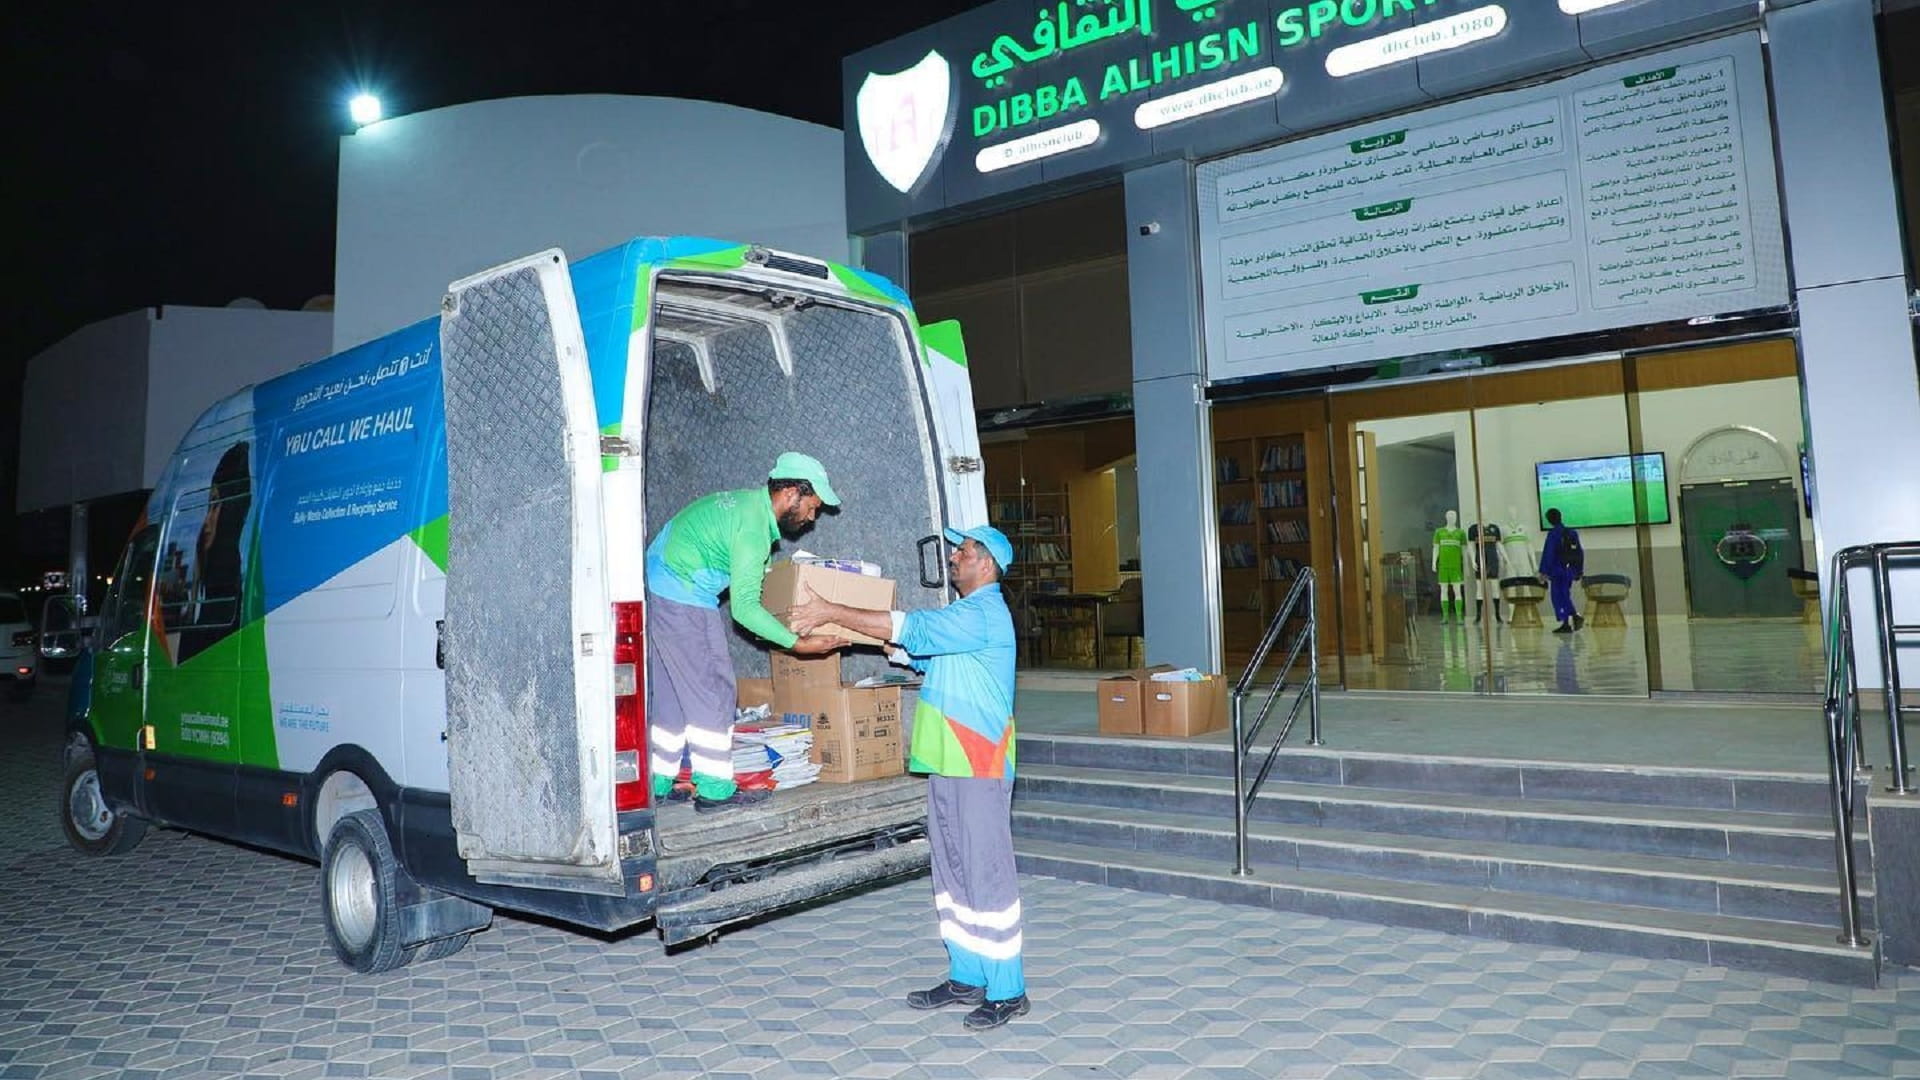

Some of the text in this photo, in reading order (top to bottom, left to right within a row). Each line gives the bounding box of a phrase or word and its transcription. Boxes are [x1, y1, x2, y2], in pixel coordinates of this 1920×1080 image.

[1382, 16, 1494, 55] dhclub.1980
[973, 84, 1087, 137] DIBBA
[1100, 22, 1259, 99] ALHISN
[1159, 79, 1272, 115] www.dhclub.ae
[1018, 131, 1083, 155] alhisnclub
[285, 406, 414, 456] YOU CALL WE HAUL
[376, 499, 398, 512] Service
